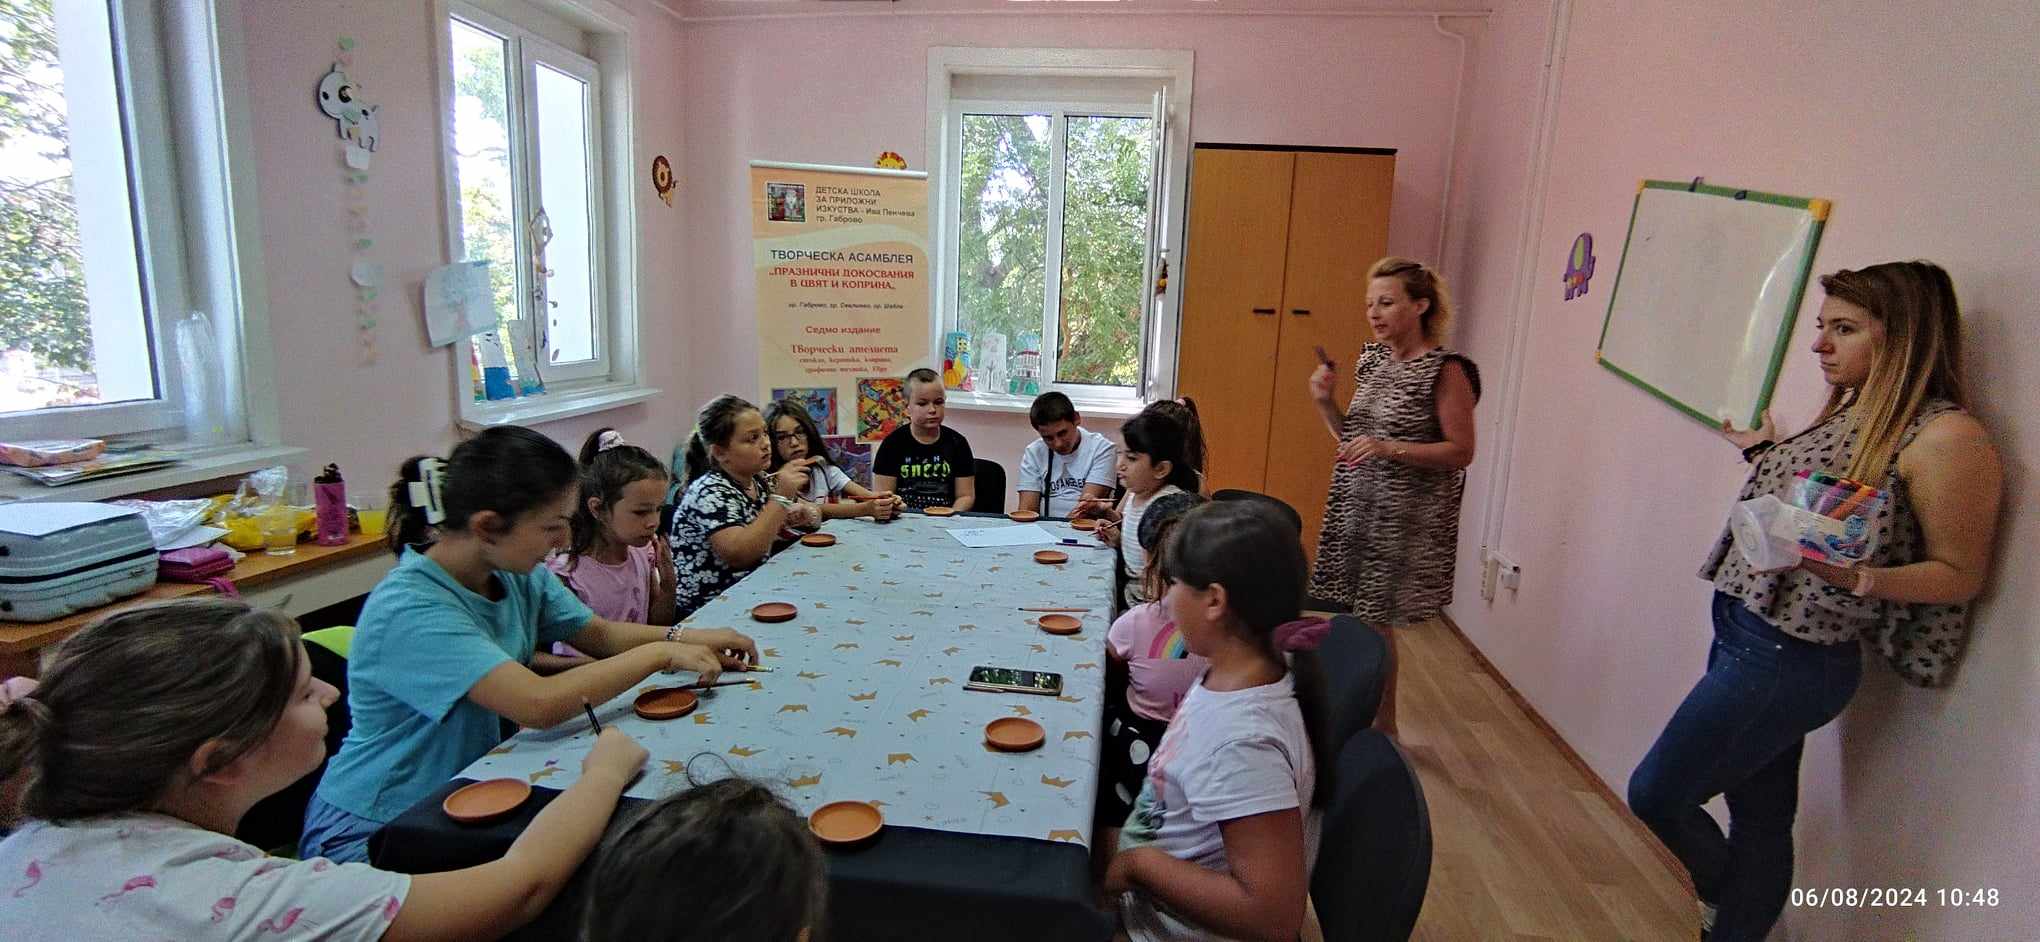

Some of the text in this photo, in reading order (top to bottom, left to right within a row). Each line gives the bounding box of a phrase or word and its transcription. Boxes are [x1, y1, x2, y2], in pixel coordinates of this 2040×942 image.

[816, 186, 881, 197] ДЕТСКА ШКОЛА
[816, 195, 877, 206] ЗА ПРИЛОЖНИ
[816, 205, 858, 214] ИЗКУСТВА
[829, 215, 863, 224] Габрово
[770, 249, 914, 264] ТВОРЧЕСКА АСАМБЛЕЯ
[843, 268, 914, 279] ДОКОСВАНИЯ
[790, 279, 798, 288] В
[800, 279, 828, 289] ЦВЯТ
[831, 281, 839, 289] И
[805, 325, 881, 335] Седмо издание
[792, 343, 845, 355] Творчески
